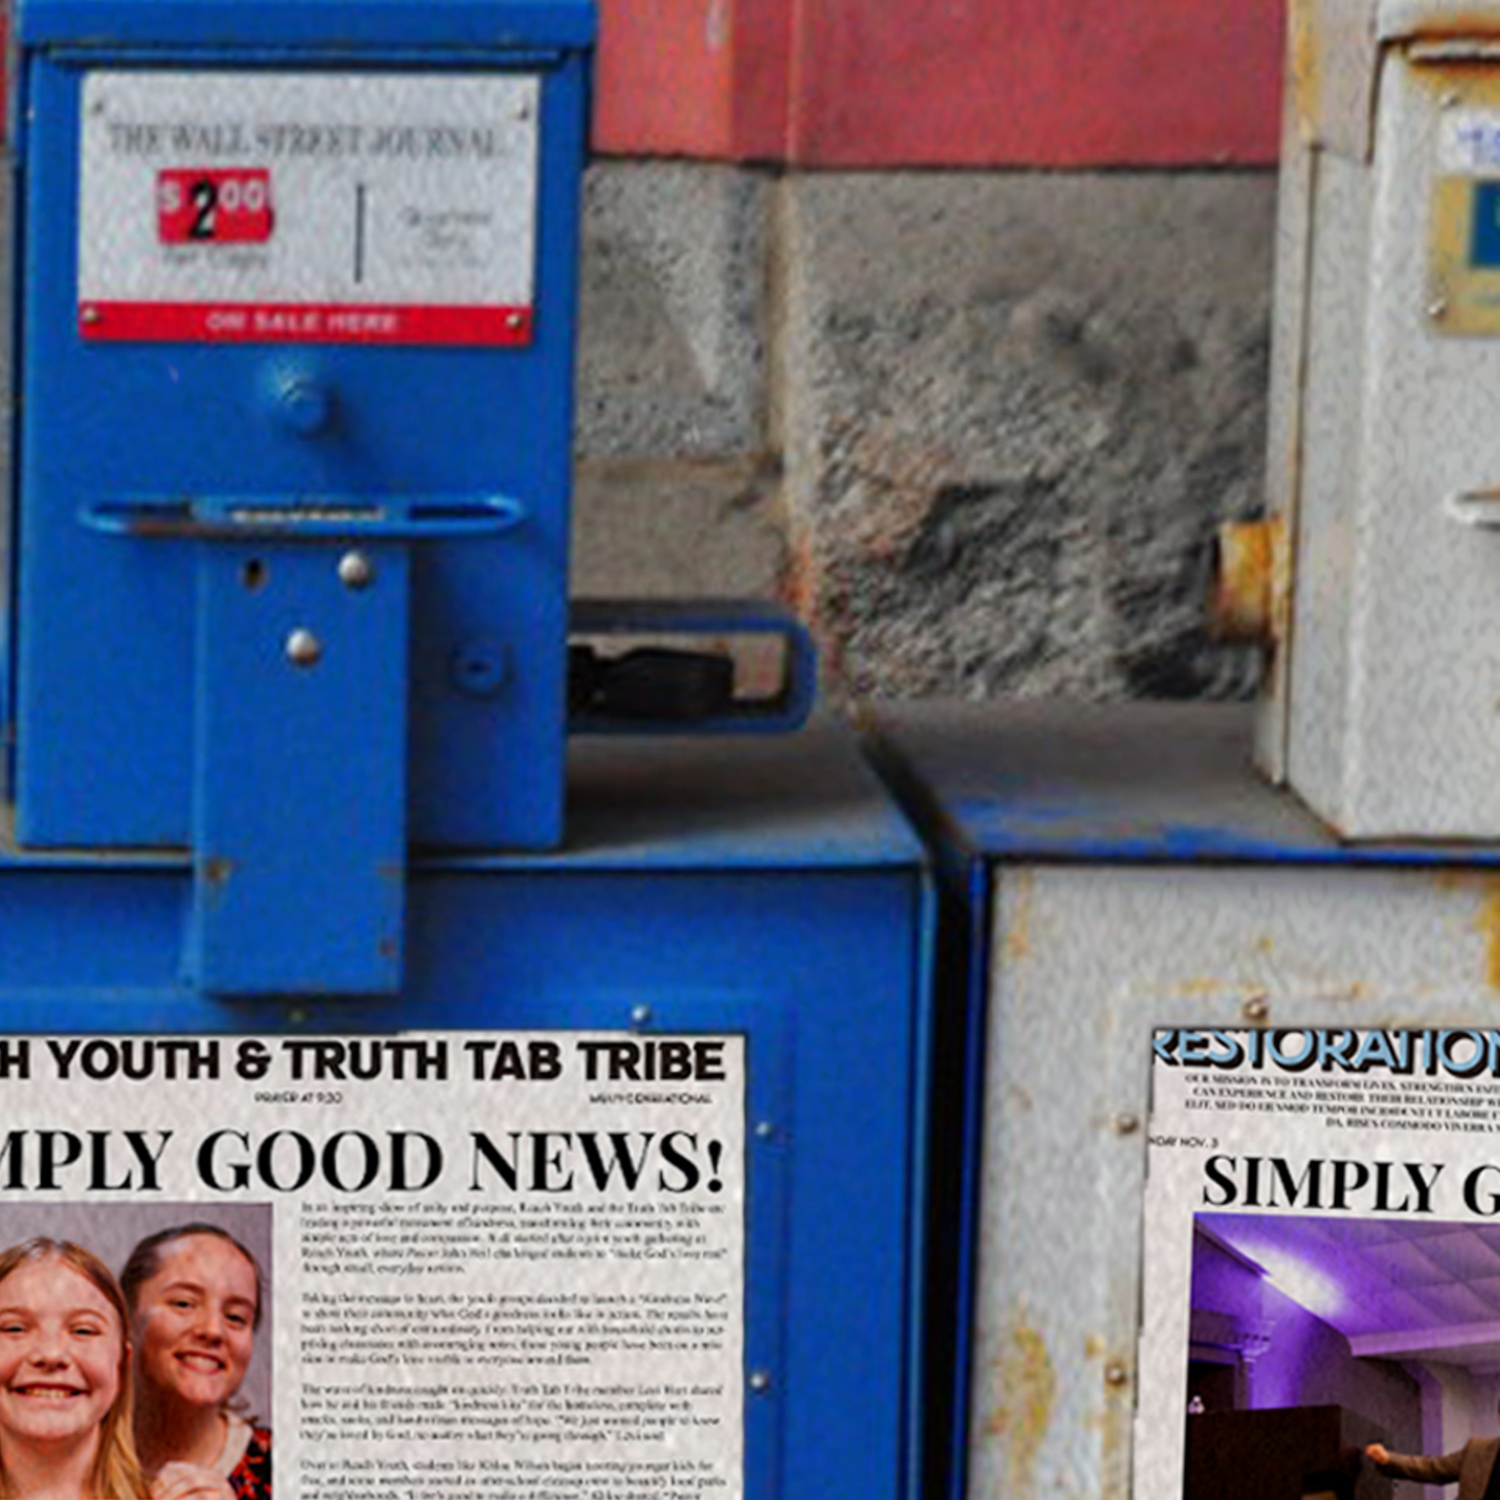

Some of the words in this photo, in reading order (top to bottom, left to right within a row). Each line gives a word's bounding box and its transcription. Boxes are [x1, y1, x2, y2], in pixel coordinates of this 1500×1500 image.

[108, 124, 162, 159] THE
[172, 124, 246, 159] WALL
[257, 124, 362, 159] STREET
[372, 124, 498, 159] JOURNAL
[206, 312, 246, 333] ON
[254, 312, 321, 333] SALE
[328, 312, 398, 333] HERE
[45, 1040, 221, 1081] YOUTH
[235, 1040, 272, 1081] &
[283, 1040, 452, 1081] TRUTH
[465, 1040, 562, 1081] TAB
[577, 1040, 726, 1081] TRIBE
[1212, 1075, 1258, 1086] MISSION
[1274, 1077, 1290, 1087] TO
[1293, 1078, 1360, 1089] TRANSFORM
[1399, 1081, 1473, 1093] STRENGTHEN
[1219, 1088, 1287, 1100] EXPERIENCE
[1290, 1090, 1313, 1100] AND
[1315, 1091, 1364, 1103] RESTORE
[1368, 1093, 1401, 1104] THEIR
[1403, 1094, 1482, 1107] RELATIONSHIP
[1215, 1100, 1237, 1110] SED
[1313, 1104, 1358, 1116] TEMPOR
[1445, 1109, 1488, 1120] LABORE
[1380, 1120, 1441, 1132] COMMODO
[1443, 1122, 1494, 1134] VIVERRA
[196, 1127, 443, 1193] GOOD
[469, 1127, 725, 1193] NEWS!
[1203, 1154, 1445, 1214] SIMPLY
